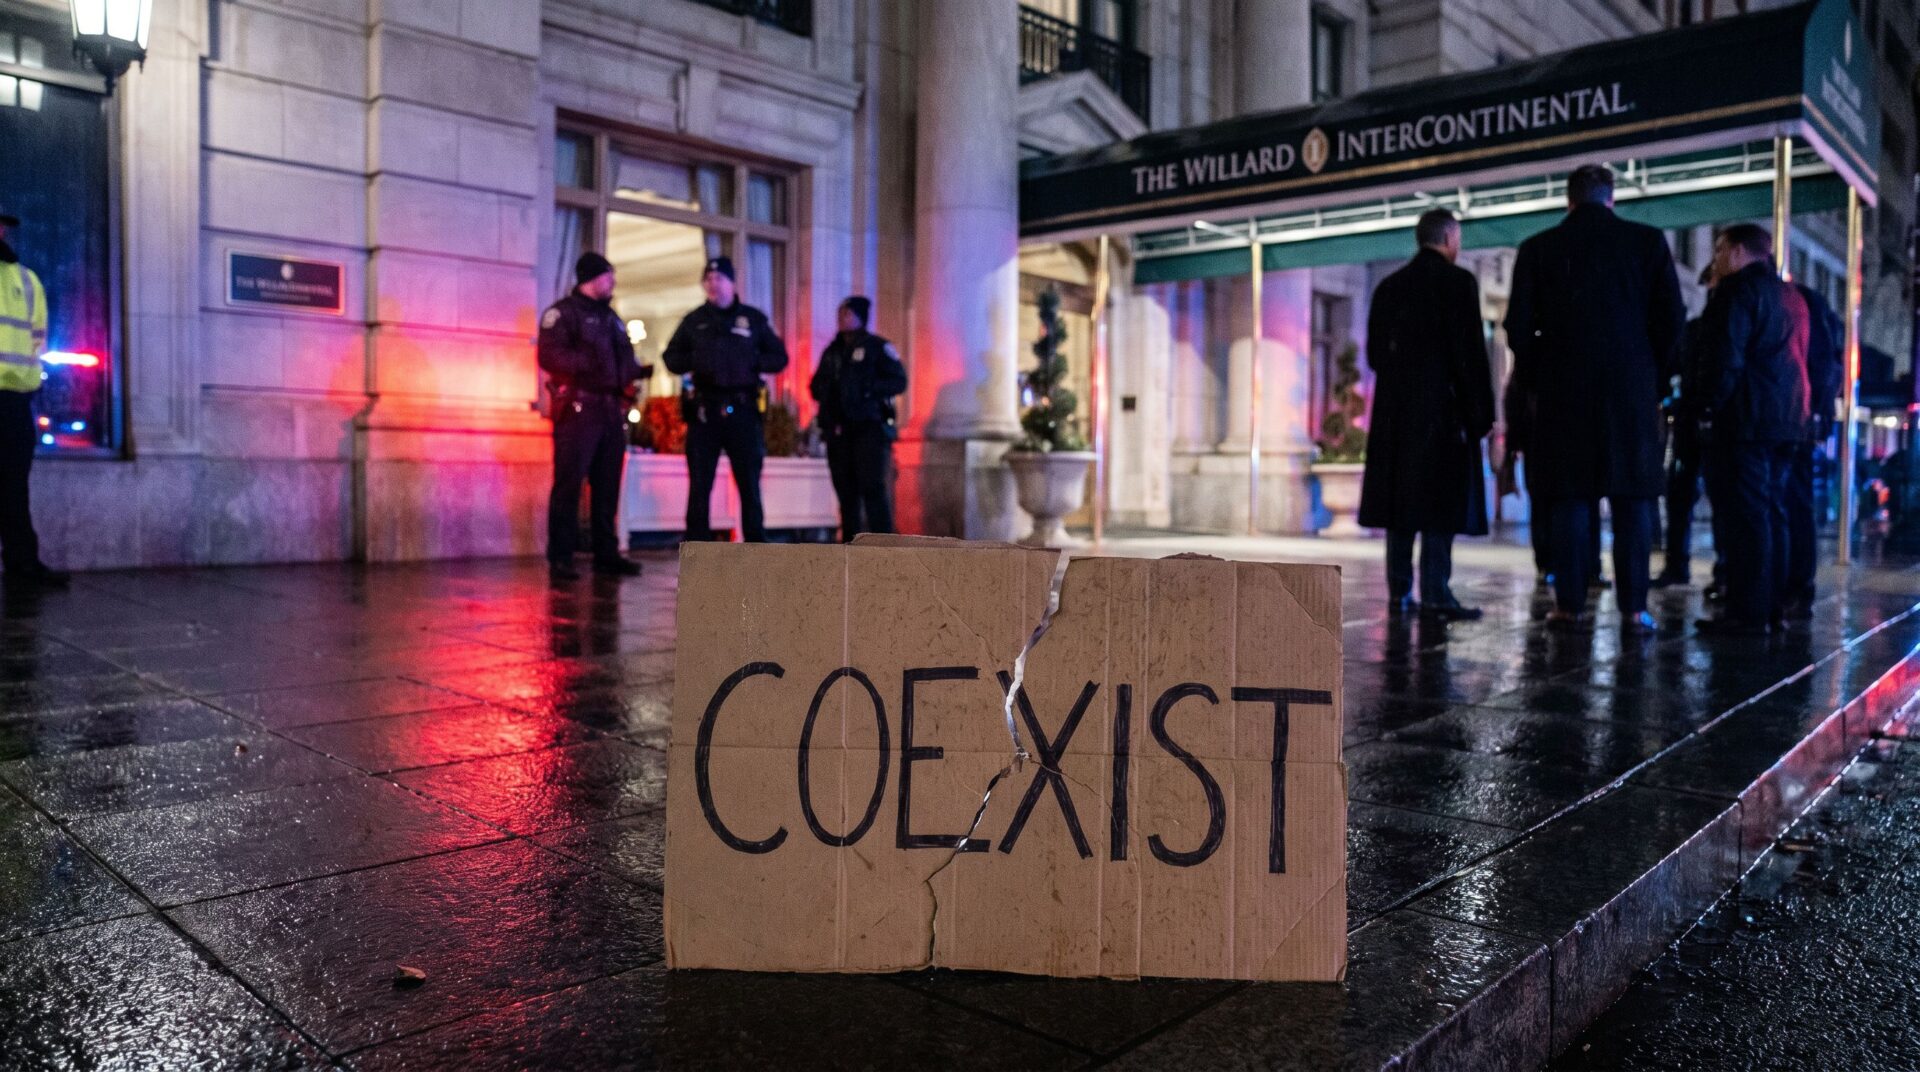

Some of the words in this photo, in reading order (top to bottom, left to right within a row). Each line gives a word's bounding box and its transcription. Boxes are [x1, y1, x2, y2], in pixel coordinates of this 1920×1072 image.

[1132, 163, 1178, 194] THE
[1183, 143, 1295, 186] WILLARD
[695, 661, 1332, 874] COEXIST
